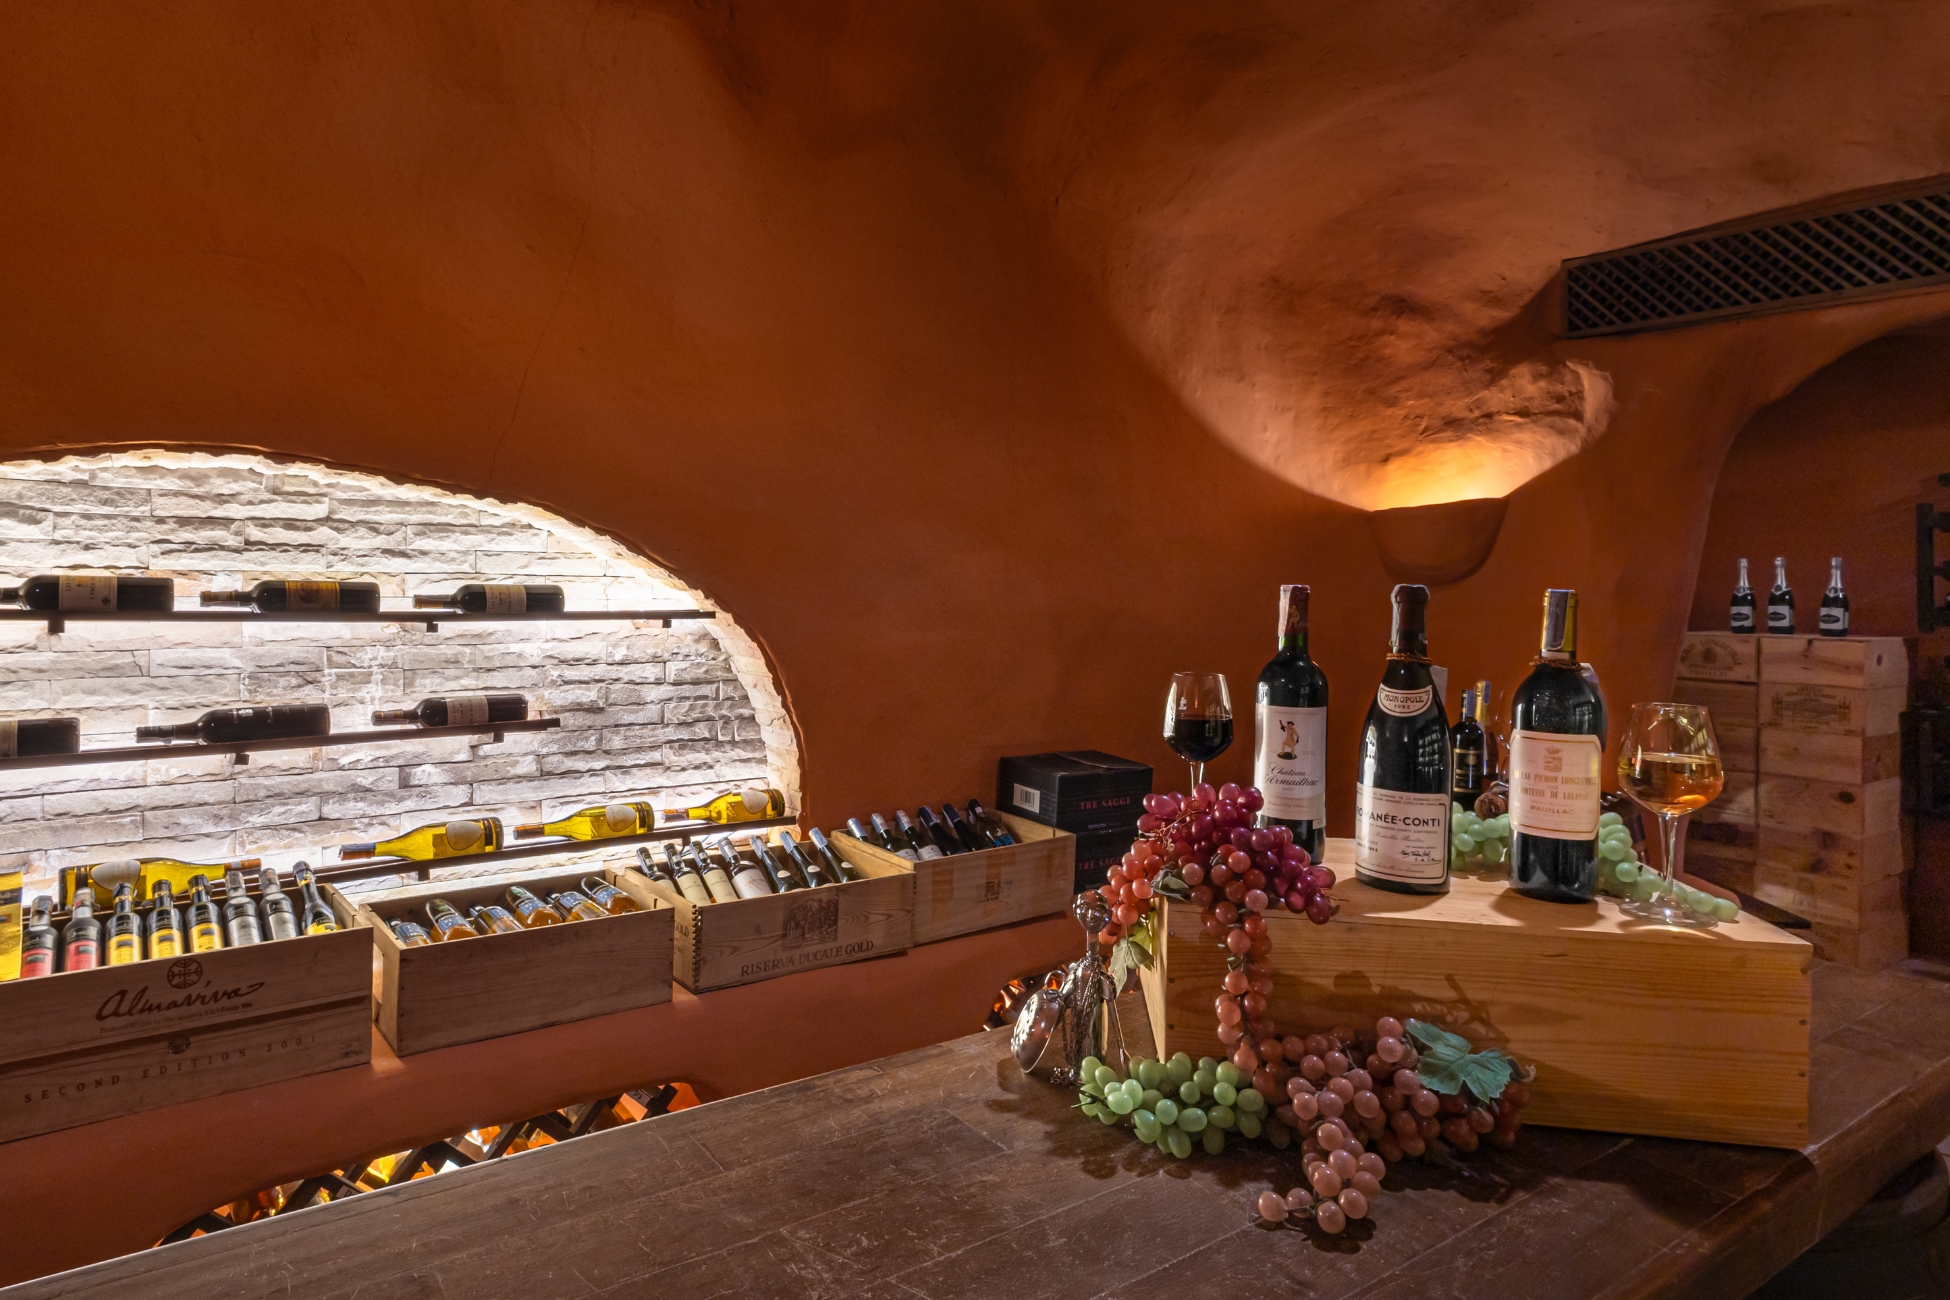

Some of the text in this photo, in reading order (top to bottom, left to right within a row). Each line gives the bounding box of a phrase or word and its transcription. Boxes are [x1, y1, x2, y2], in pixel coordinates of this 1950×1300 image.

[1383, 693, 1425, 704] MONOPOLE
[1268, 761, 1307, 776] Château
[1533, 773, 1559, 784] PICHON
[1550, 790, 1559, 799] DE
[1079, 796, 1131, 810] TRE SAGGI
[1530, 804, 1575, 814] PAUILLAC
[1078, 861, 1095, 870] TRE
[740, 940, 875, 978] RISERVA DUCALE GOLD
[95, 979, 266, 1022] Almaviva
[24, 1035, 317, 1104] SECOND EDITION 2001
